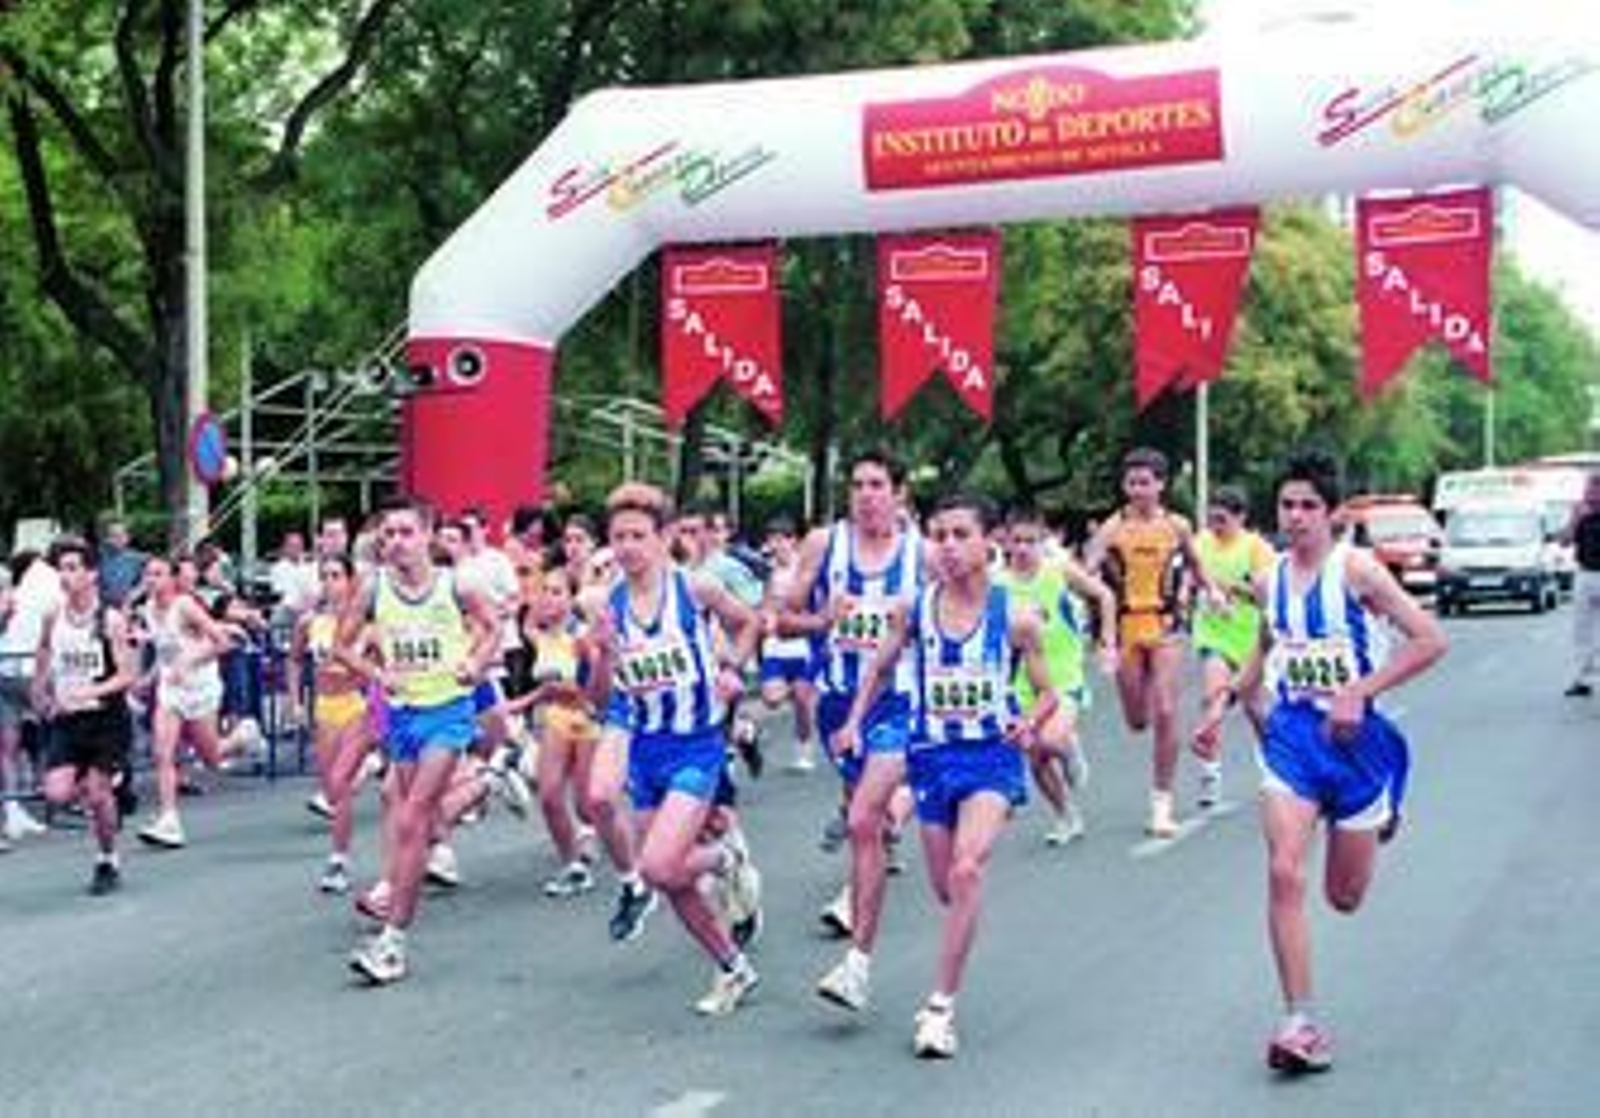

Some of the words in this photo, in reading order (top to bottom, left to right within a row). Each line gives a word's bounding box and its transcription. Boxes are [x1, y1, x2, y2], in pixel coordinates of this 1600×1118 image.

[873, 117, 1026, 156] INSTITUTO
[1057, 99, 1213, 143] DEPORTES
[667, 298, 774, 396] SALIDA
[886, 283, 985, 391] SALIDA
[1364, 250, 1485, 352] SALIDA
